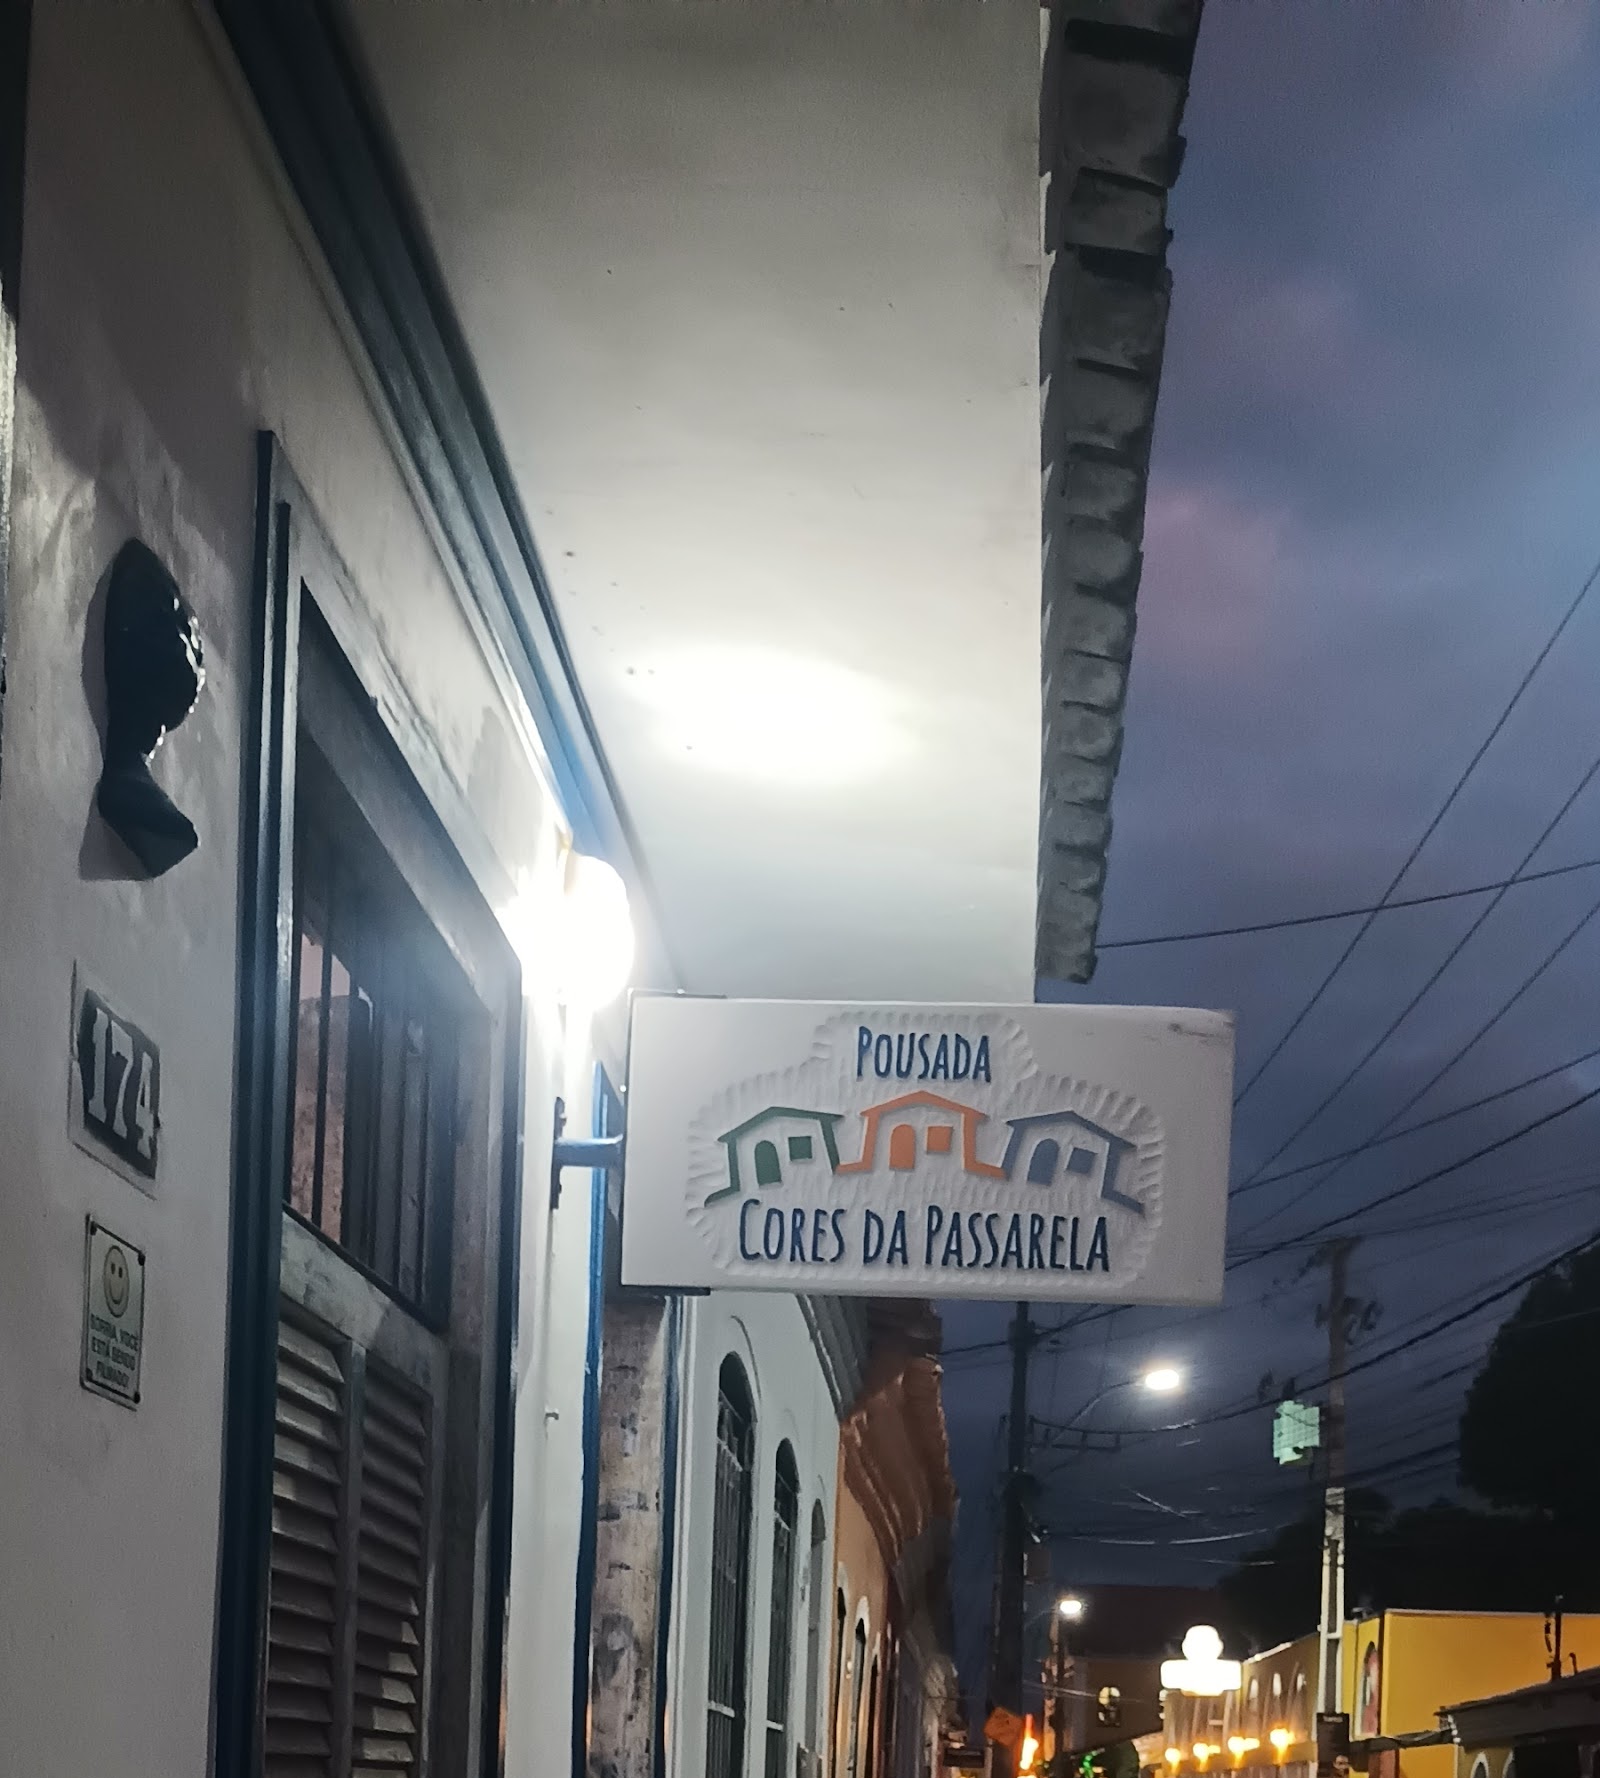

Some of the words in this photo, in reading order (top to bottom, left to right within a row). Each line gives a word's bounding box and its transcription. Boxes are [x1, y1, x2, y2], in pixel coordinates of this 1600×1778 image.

[88, 1008, 154, 1160] 174
[857, 1025, 992, 1083] POUSADA
[739, 1199, 846, 1265] CORES
[863, 1209, 909, 1266] DA
[924, 1204, 1111, 1272] PASSARELA
